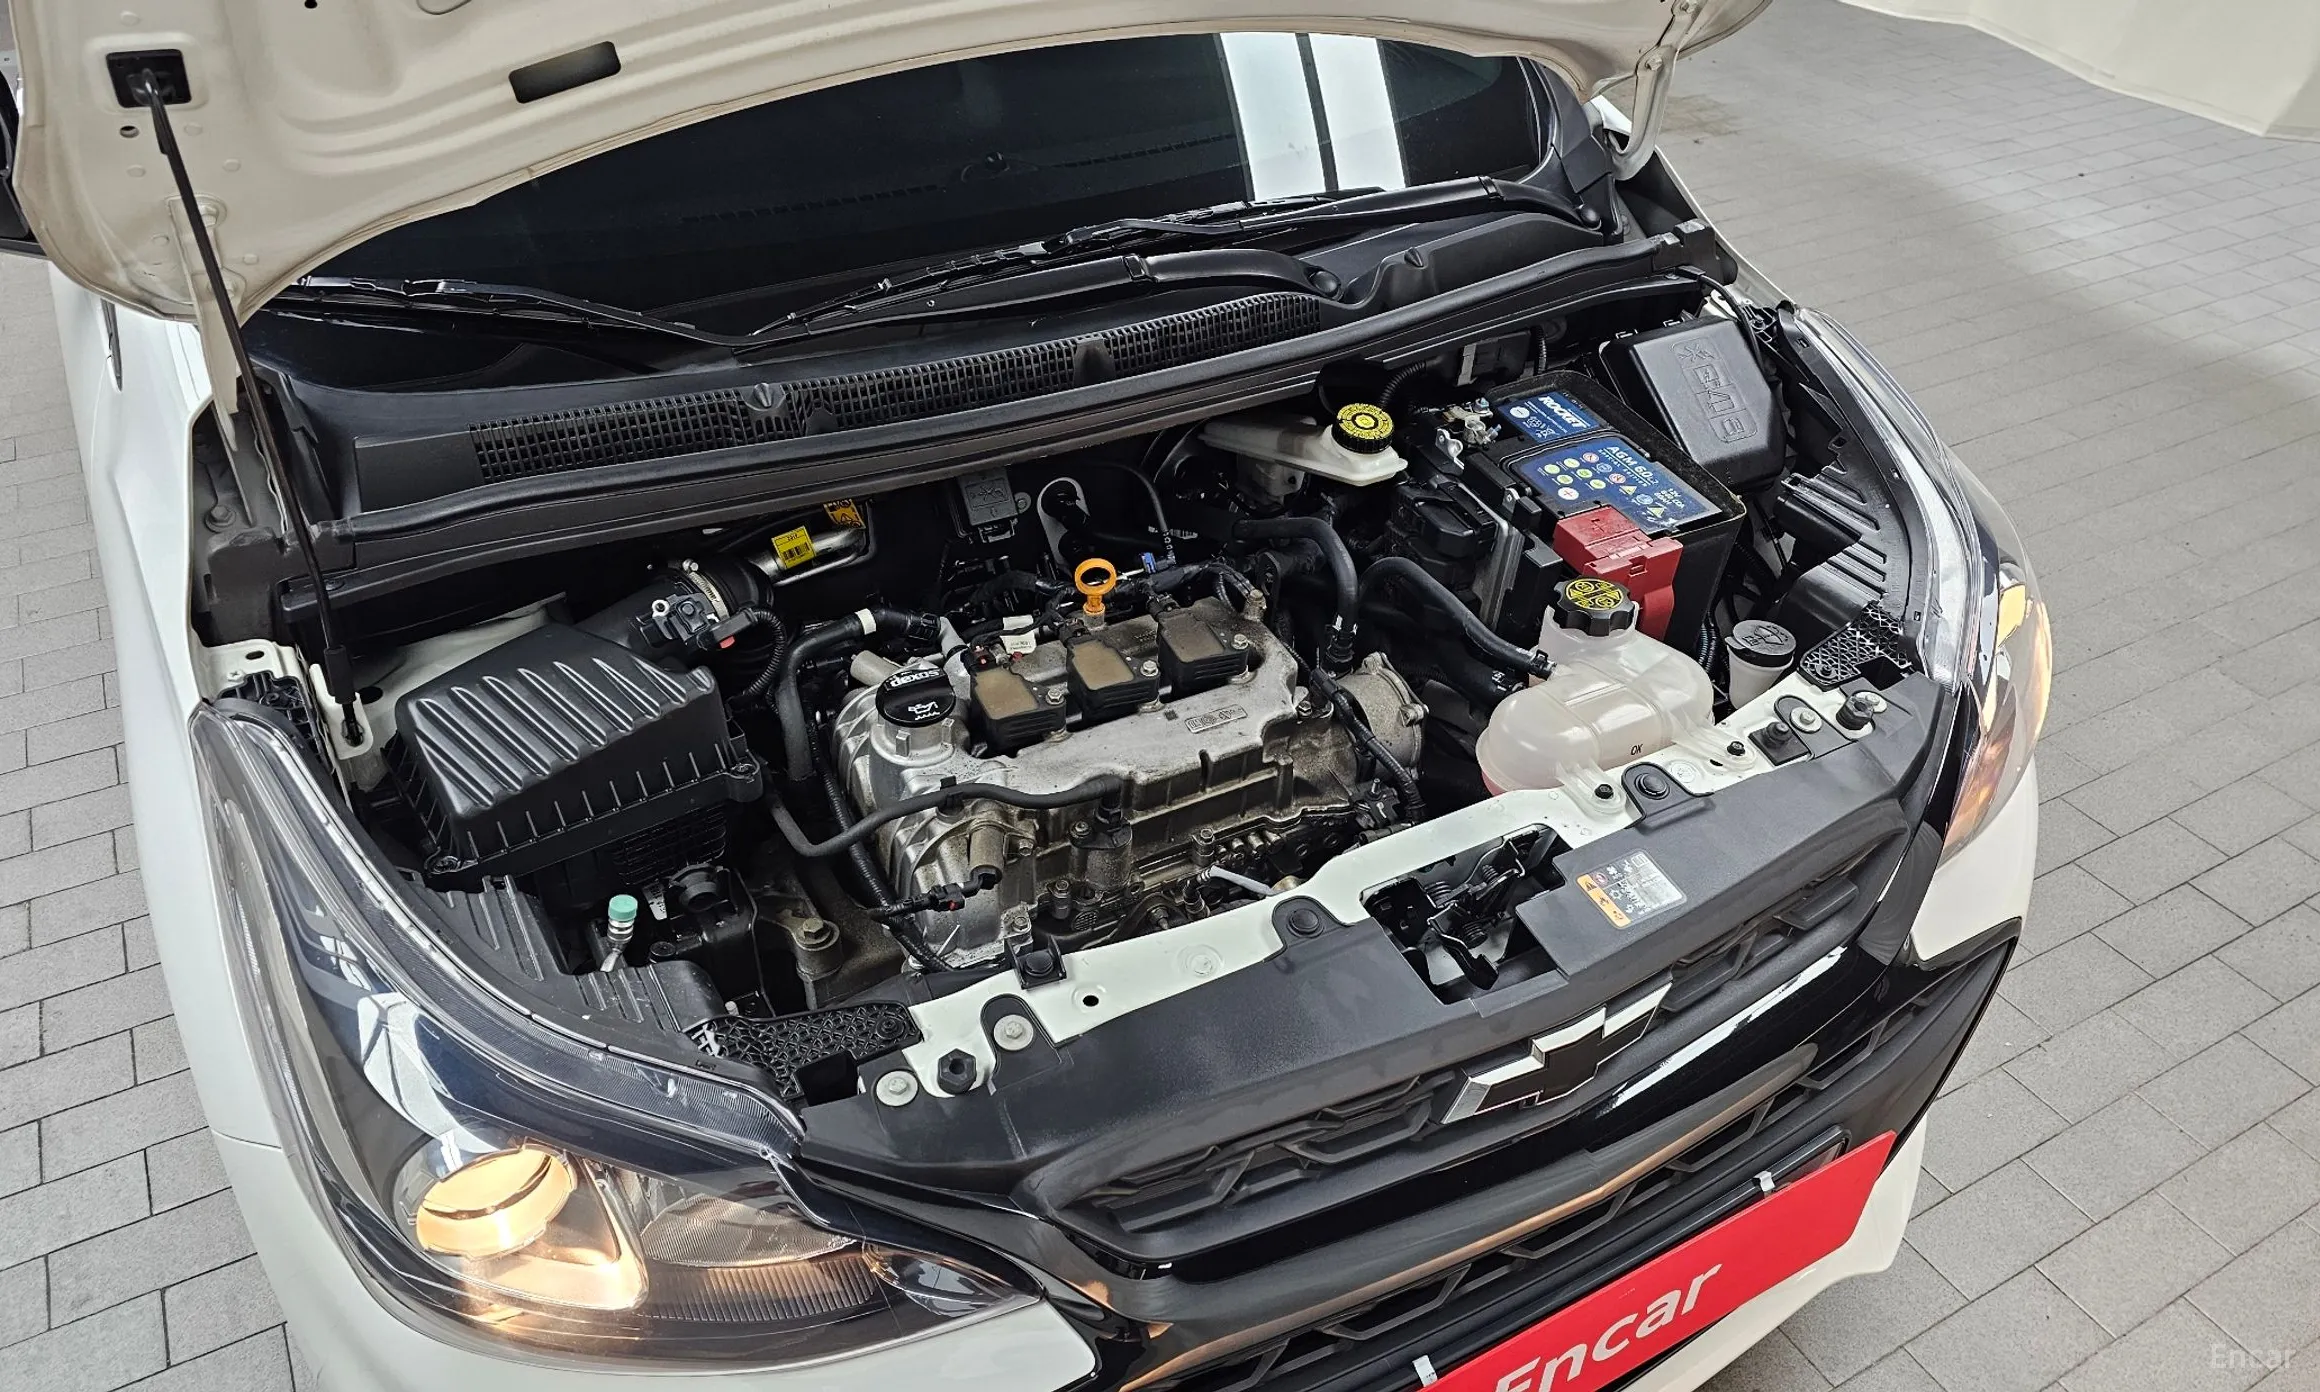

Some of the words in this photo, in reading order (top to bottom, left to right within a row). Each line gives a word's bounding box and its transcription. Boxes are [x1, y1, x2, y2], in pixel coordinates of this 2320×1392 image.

[1538, 396, 1587, 428] ROCKET
[1606, 446, 1638, 466] AGM
[890, 670, 940, 687] dexos
[1630, 743, 1643, 756] OK
[1495, 1264, 1722, 1392] Encar
